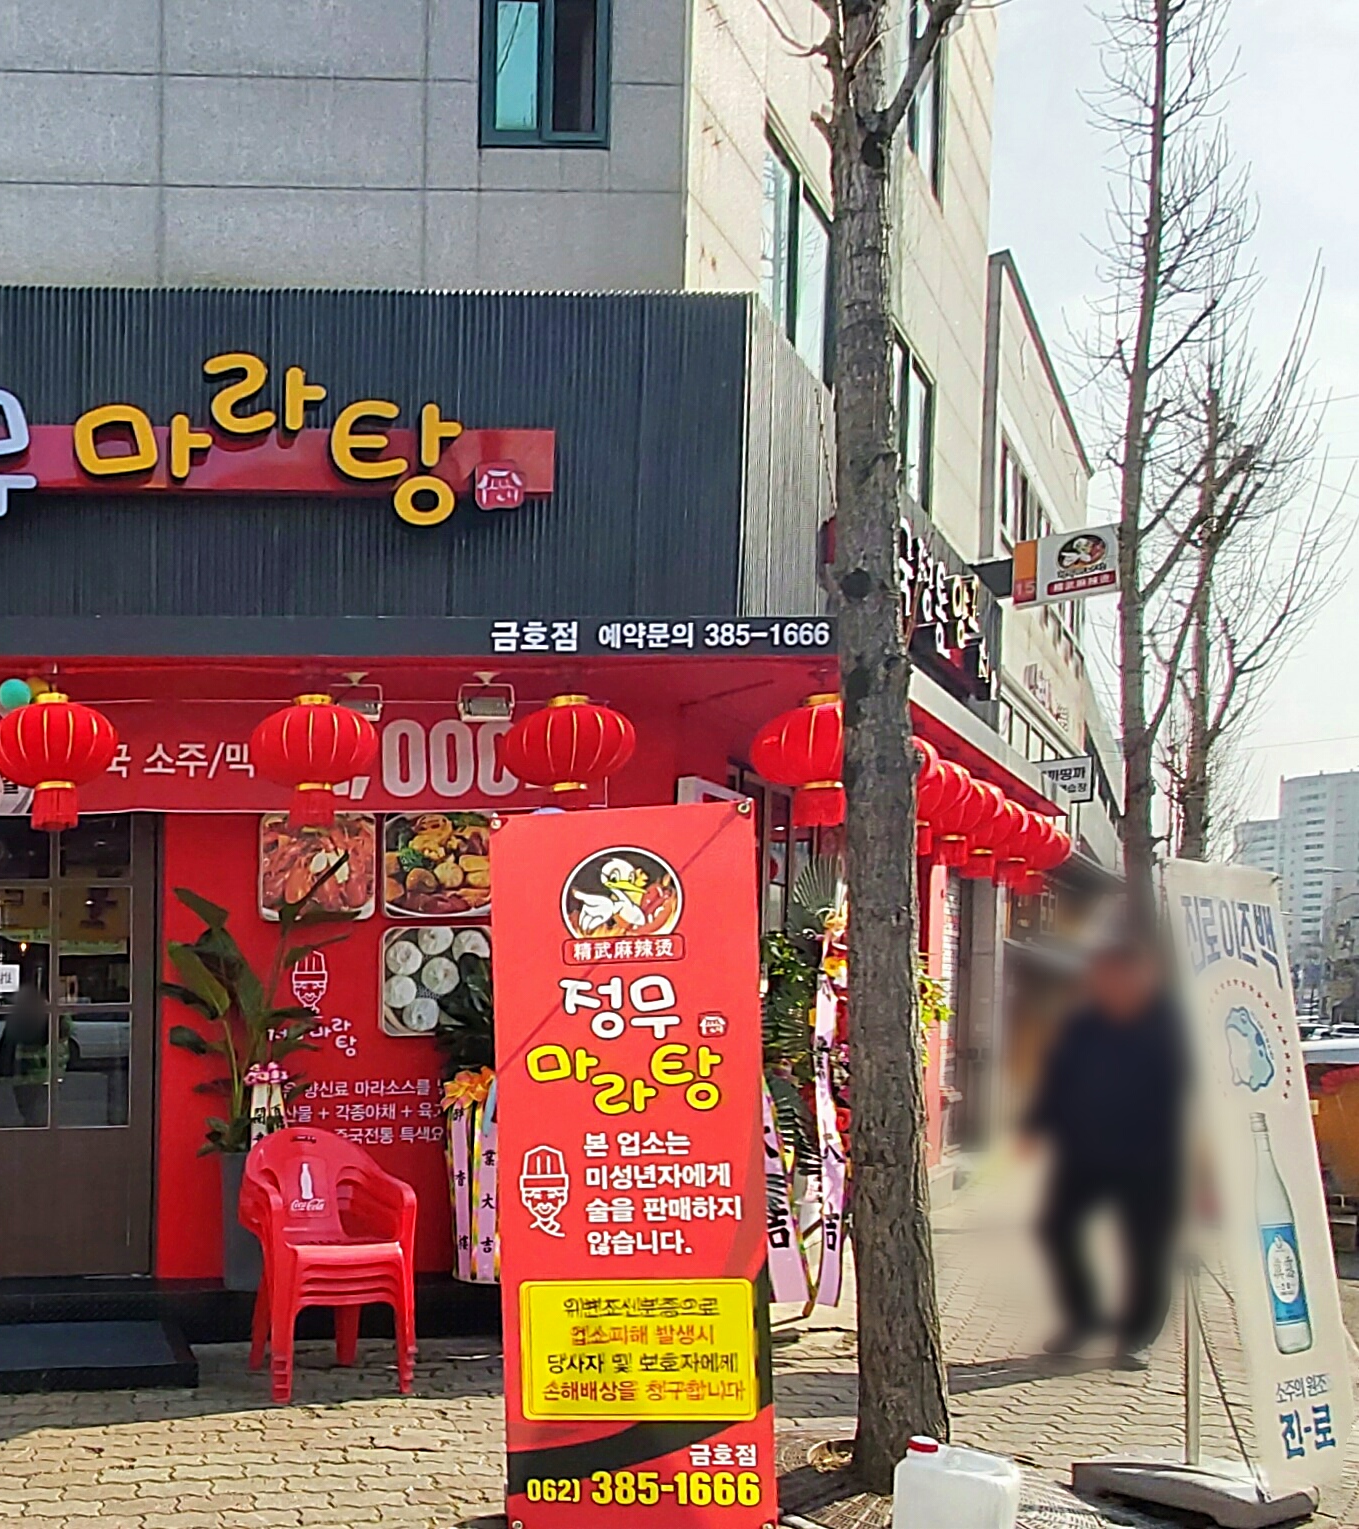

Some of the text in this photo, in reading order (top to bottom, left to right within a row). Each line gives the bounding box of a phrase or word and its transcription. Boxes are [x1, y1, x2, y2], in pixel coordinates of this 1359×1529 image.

[73, 351, 463, 527] 마라탕
[491, 620, 830, 653] 금호점 예약문의 385-1666
[573, 937, 675, 961] 精武麻辣烫
[559, 975, 682, 1040] 정무
[354, 1078, 431, 1098] 마라소스를
[526, 1044, 723, 1115] 마라탕
[583, 1131, 692, 1158] 본 업소는
[585, 1162, 732, 1191] 미성년자에게
[585, 1194, 743, 1223] 술을 판매하지
[587, 1229, 694, 1256] 않습니다.
[547, 1352, 605, 1375] 당사자
[541, 1380, 638, 1403] 손해배상을
[689, 1443, 757, 1468] 금호점
[526, 1470, 761, 1507] 062) 385-1666
